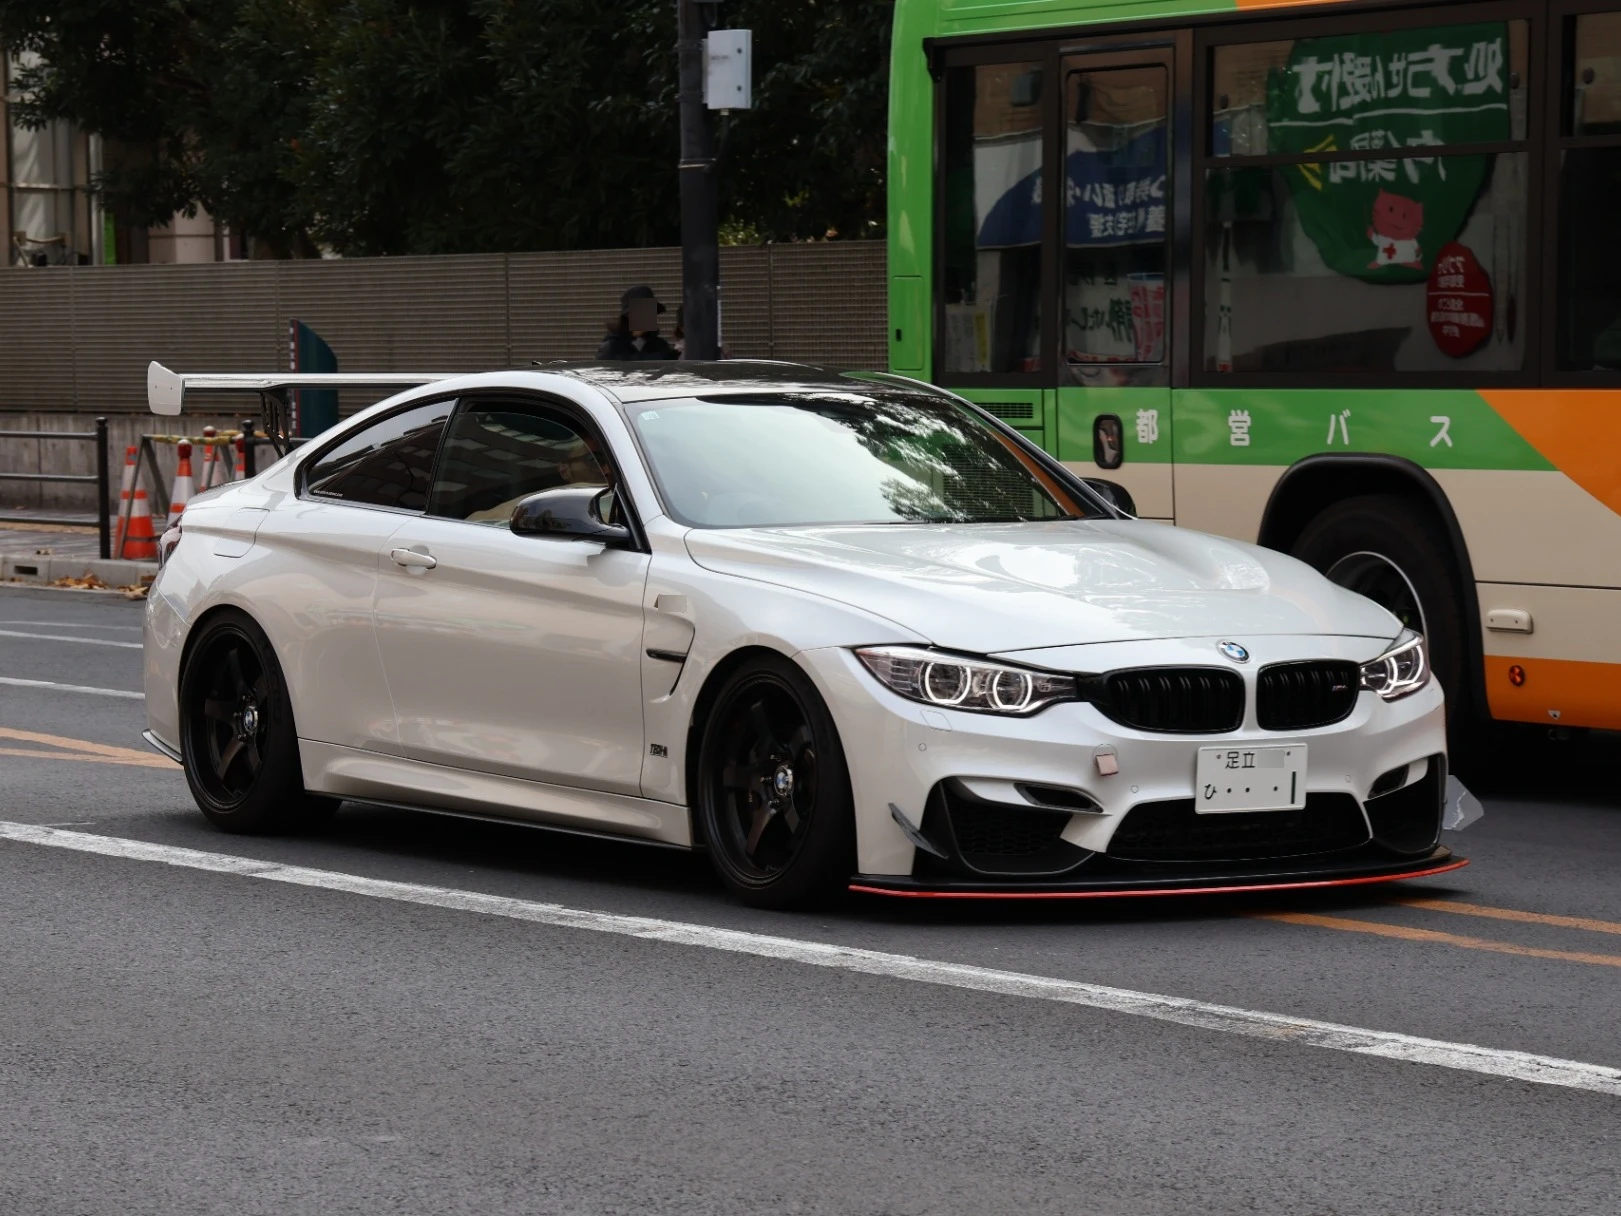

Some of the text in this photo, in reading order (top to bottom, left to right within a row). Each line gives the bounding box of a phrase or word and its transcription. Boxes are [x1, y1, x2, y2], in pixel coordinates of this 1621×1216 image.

[1136, 408, 1454, 448] 都営バス
[1225, 751, 1256, 769] 足立
[1204, 783, 1217, 800] ひ
